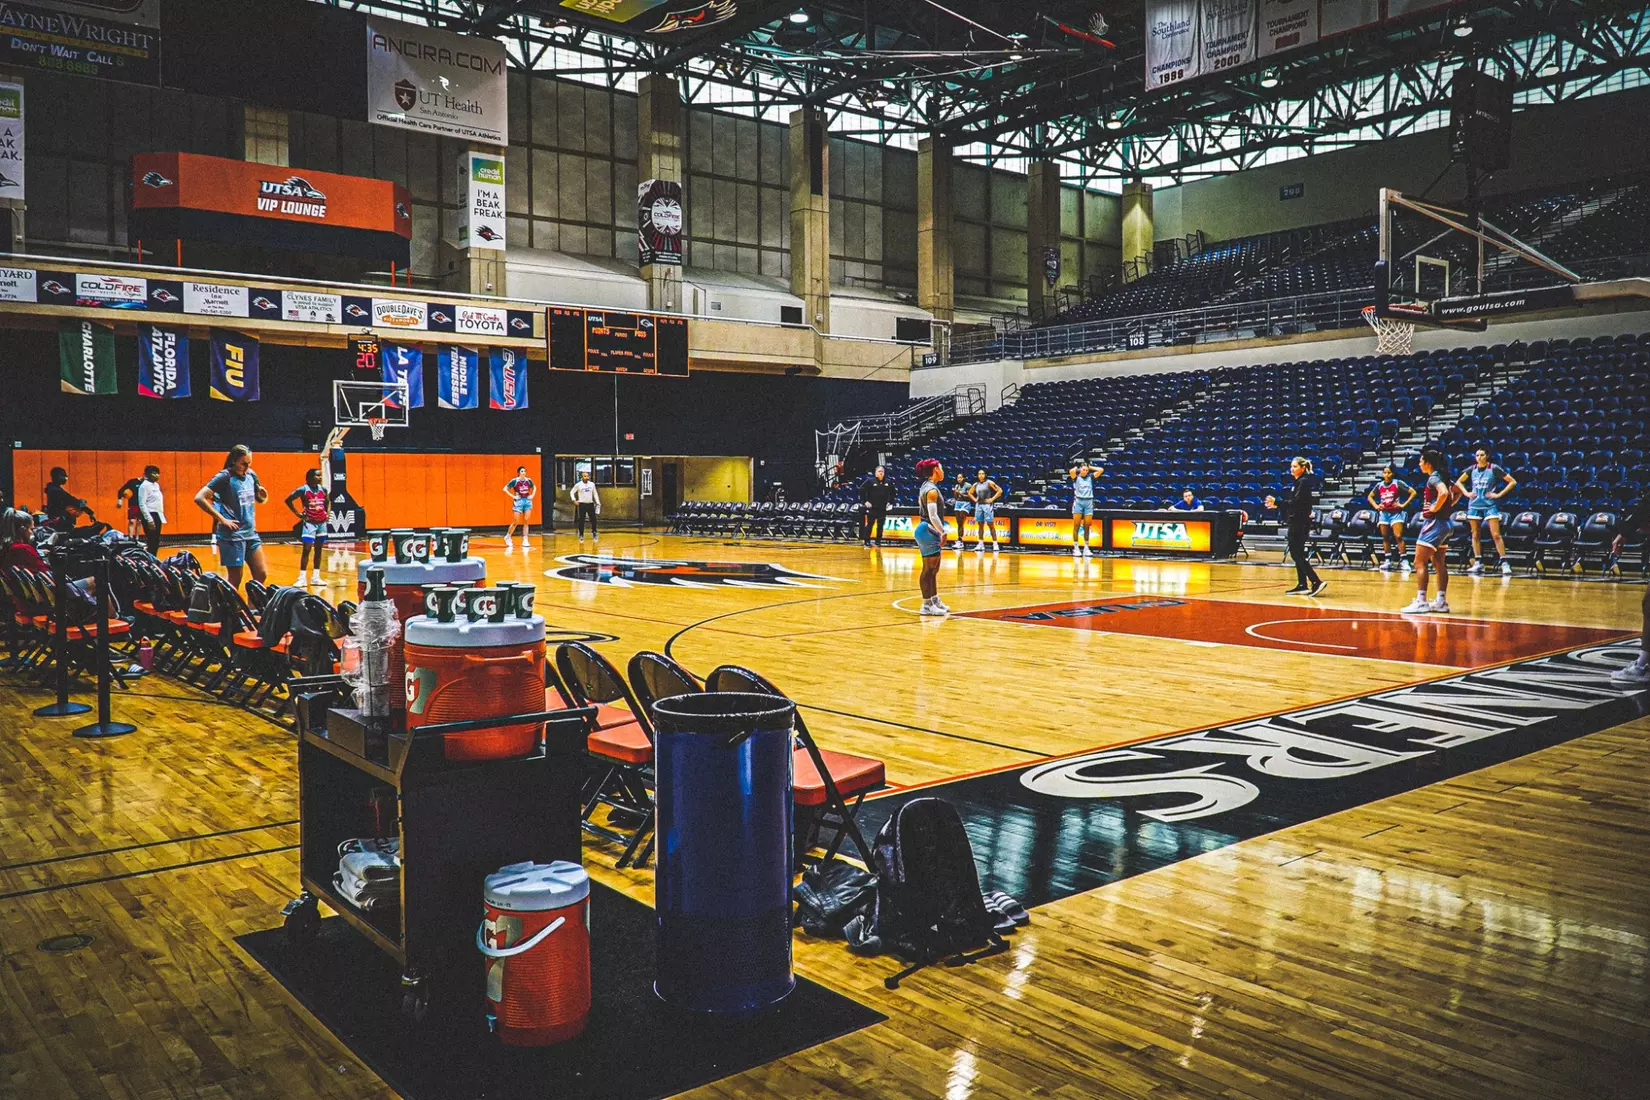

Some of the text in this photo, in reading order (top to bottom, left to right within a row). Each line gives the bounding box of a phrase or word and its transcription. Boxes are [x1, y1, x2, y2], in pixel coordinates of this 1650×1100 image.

[1152, 17, 1191, 37] Southland
[1206, 31, 1249, 50] TOURNAMENT
[87, 51, 113, 65] CALL
[373, 34, 502, 76] ANCIRA.COM
[1206, 41, 1247, 59] CHAMPIONS
[1152, 56, 1191, 74] CHAMPIONS
[1214, 54, 1240, 70] 2000
[419, 90, 483, 115] UT Health
[478, 172, 502, 181] human
[480, 167, 500, 176] credit
[261, 181, 303, 197] UTSA
[477, 189, 499, 200] I'M A
[257, 197, 327, 218] VIP LOUNGE
[476, 198, 500, 210] BEAK
[81, 281, 142, 293] COLDFIRE
[192, 284, 240, 295] Residence
[314, 296, 337, 304] FAMILY
[1441, 298, 1526, 315] www.goutsa.com
[458, 318, 504, 331] TOYOTA
[1130, 337, 1145, 347] 108
[81, 321, 96, 394] CHARLOTTE
[151, 325, 165, 396] ATLANTIC
[163, 332, 177, 391] FLORIDA
[357, 352, 376, 368] 20
[397, 346, 409, 365] LA
[925, 356, 937, 365] 109
[224, 343, 244, 389] FIU
[450, 345, 459, 406] TENNESSEE
[458, 355, 467, 396] MIDDLE
[1135, 522, 1188, 540] UTSA
[413, 539, 427, 558] G
[484, 595, 497, 616] G
